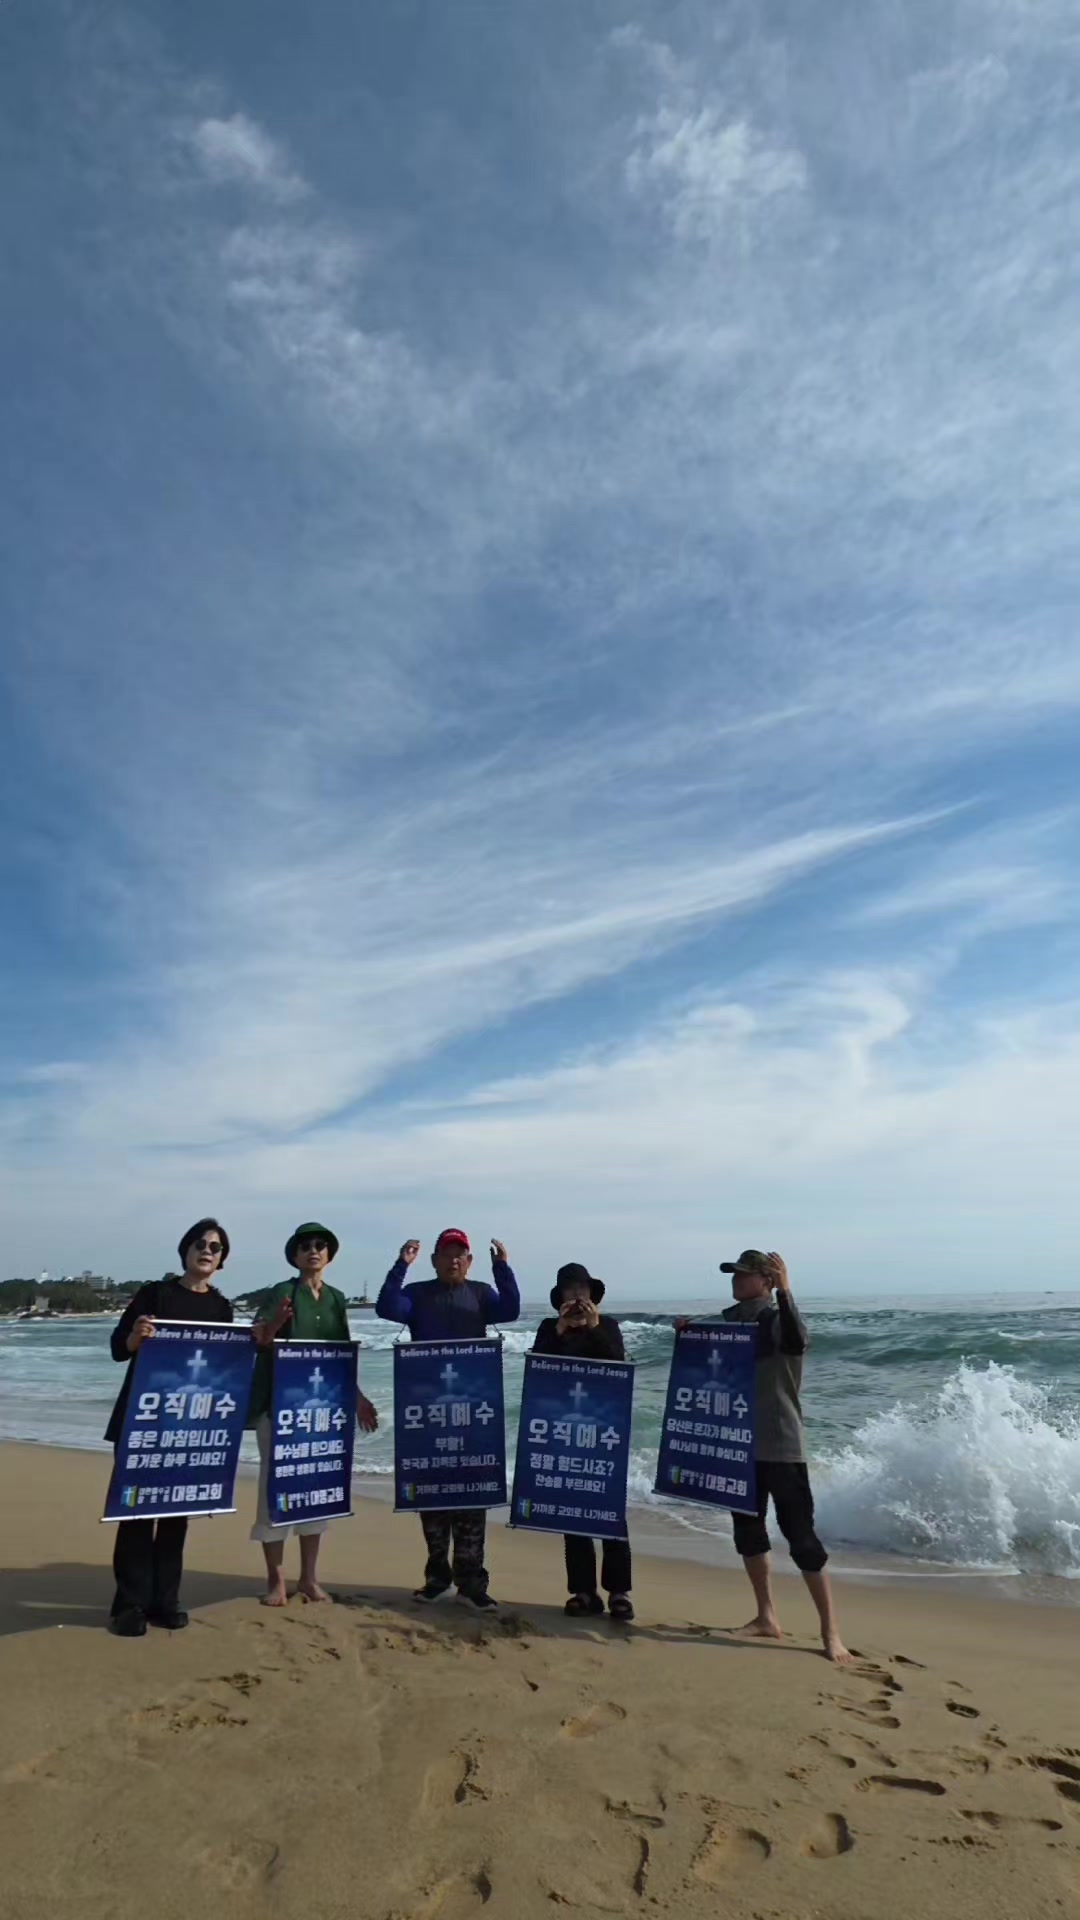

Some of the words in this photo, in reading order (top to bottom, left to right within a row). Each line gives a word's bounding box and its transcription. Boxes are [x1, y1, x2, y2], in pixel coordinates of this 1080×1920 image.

[183, 1329, 192, 1340] in
[194, 1330, 207, 1340] the
[209, 1331, 228, 1341] Lord
[709, 1331, 719, 1341] the
[303, 1348, 310, 1358] in
[311, 1348, 322, 1358] the
[400, 1348, 430, 1358] Believe
[431, 1347, 439, 1356] in
[441, 1345, 454, 1356] the
[455, 1345, 473, 1355] Lord
[475, 1345, 496, 1354] Jesus
[531, 1360, 560, 1371] Believe
[562, 1362, 571, 1372] in
[572, 1364, 586, 1373] the
[587, 1366, 605, 1376] Lord
[606, 1367, 629, 1379] Jesus
[134, 1392, 236, 1421] 오직예수
[674, 1387, 748, 1419] 오직예수
[276, 1407, 348, 1436] 오직예수
[404, 1401, 495, 1429] 오직예수
[528, 1418, 621, 1451] 오직예수
[666, 1418, 693, 1435] 당신은
[693, 1422, 719, 1439] 혼자가
[128, 1431, 157, 1449] 좋은
[160, 1429, 232, 1448] 아침입니다.
[435, 1436, 465, 1451] 부활!
[126, 1453, 162, 1470] 즐거운
[163, 1453, 187, 1468] 하루
[188, 1451, 227, 1467] 되세요!
[401, 1457, 430, 1470] 천국과
[431, 1456, 458, 1468] 지옥은
[460, 1454, 500, 1467] 있습니다.
[530, 1453, 555, 1471] 정말
[558, 1455, 615, 1477] 힘드시죠?
[171, 1483, 223, 1503] 대명교회
[535, 1473, 563, 1489] 찬송을
[565, 1477, 606, 1494] 부르세요!
[705, 1474, 747, 1496] 대명교회
[310, 1487, 345, 1506] 대명교회
[531, 1502, 556, 1516] 가까운
[557, 1505, 582, 1518] 교회로
